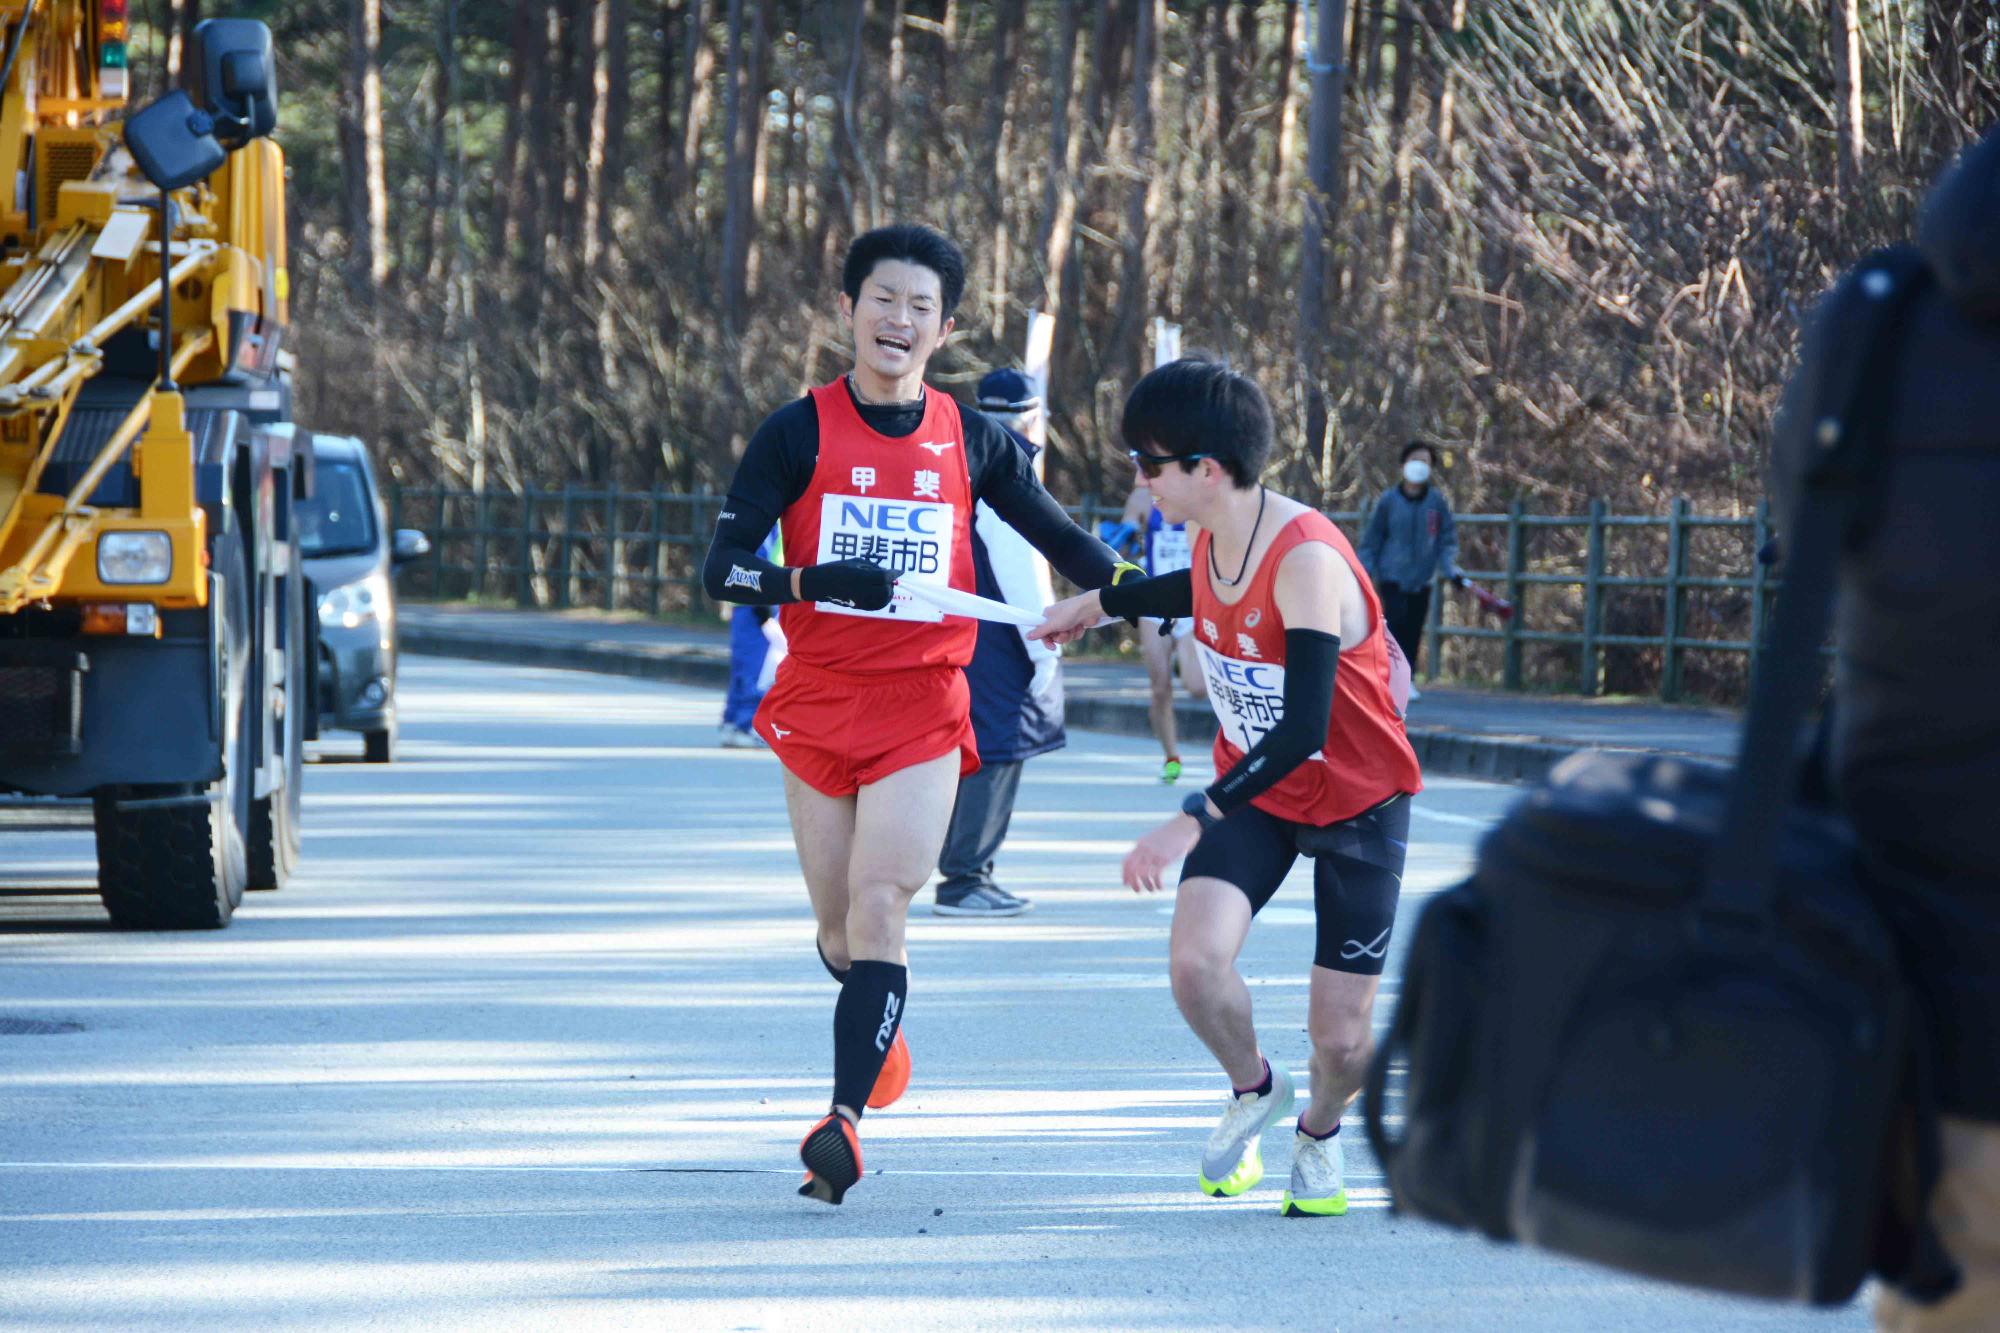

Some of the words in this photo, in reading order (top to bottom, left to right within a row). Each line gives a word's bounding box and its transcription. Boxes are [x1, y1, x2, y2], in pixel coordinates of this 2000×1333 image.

[852, 466, 876, 495] 甲
[841, 501, 938, 535] NEC
[830, 531, 940, 574] 甲斐市B
[724, 564, 762, 592] JAPAN
[1203, 649, 1275, 690] NEC
[874, 991, 900, 1052] 2XU
